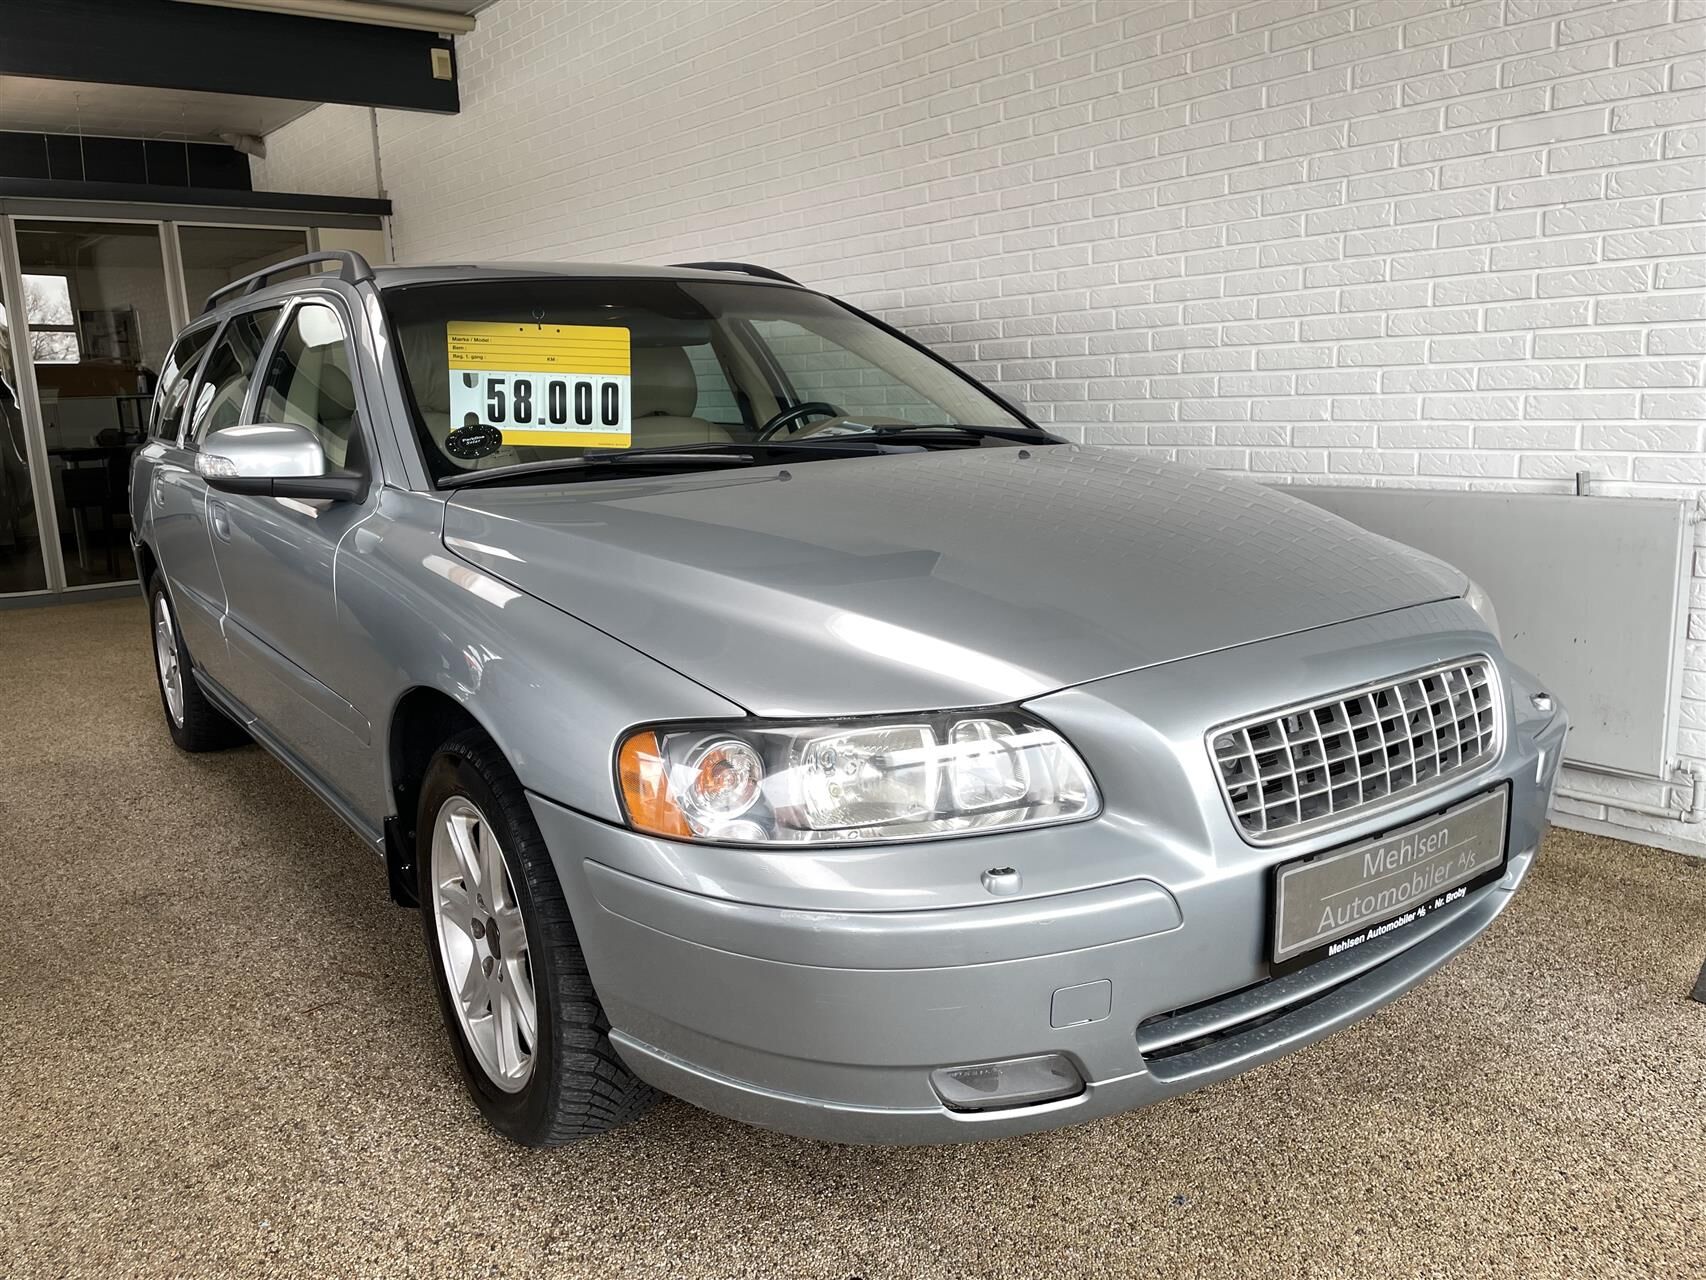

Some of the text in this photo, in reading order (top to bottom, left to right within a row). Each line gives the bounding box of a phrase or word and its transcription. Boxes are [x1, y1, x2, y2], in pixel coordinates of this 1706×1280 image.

[487, 378, 619, 425] 58.000
[1362, 828, 1448, 878] Mehlsen
[1317, 862, 1453, 933] Automobiler
[1328, 933, 1365, 956] Mehlsen
[1366, 912, 1416, 940] Automobiler
[1434, 898, 1445, 910] Nr.
[1445, 887, 1467, 904] Broby
